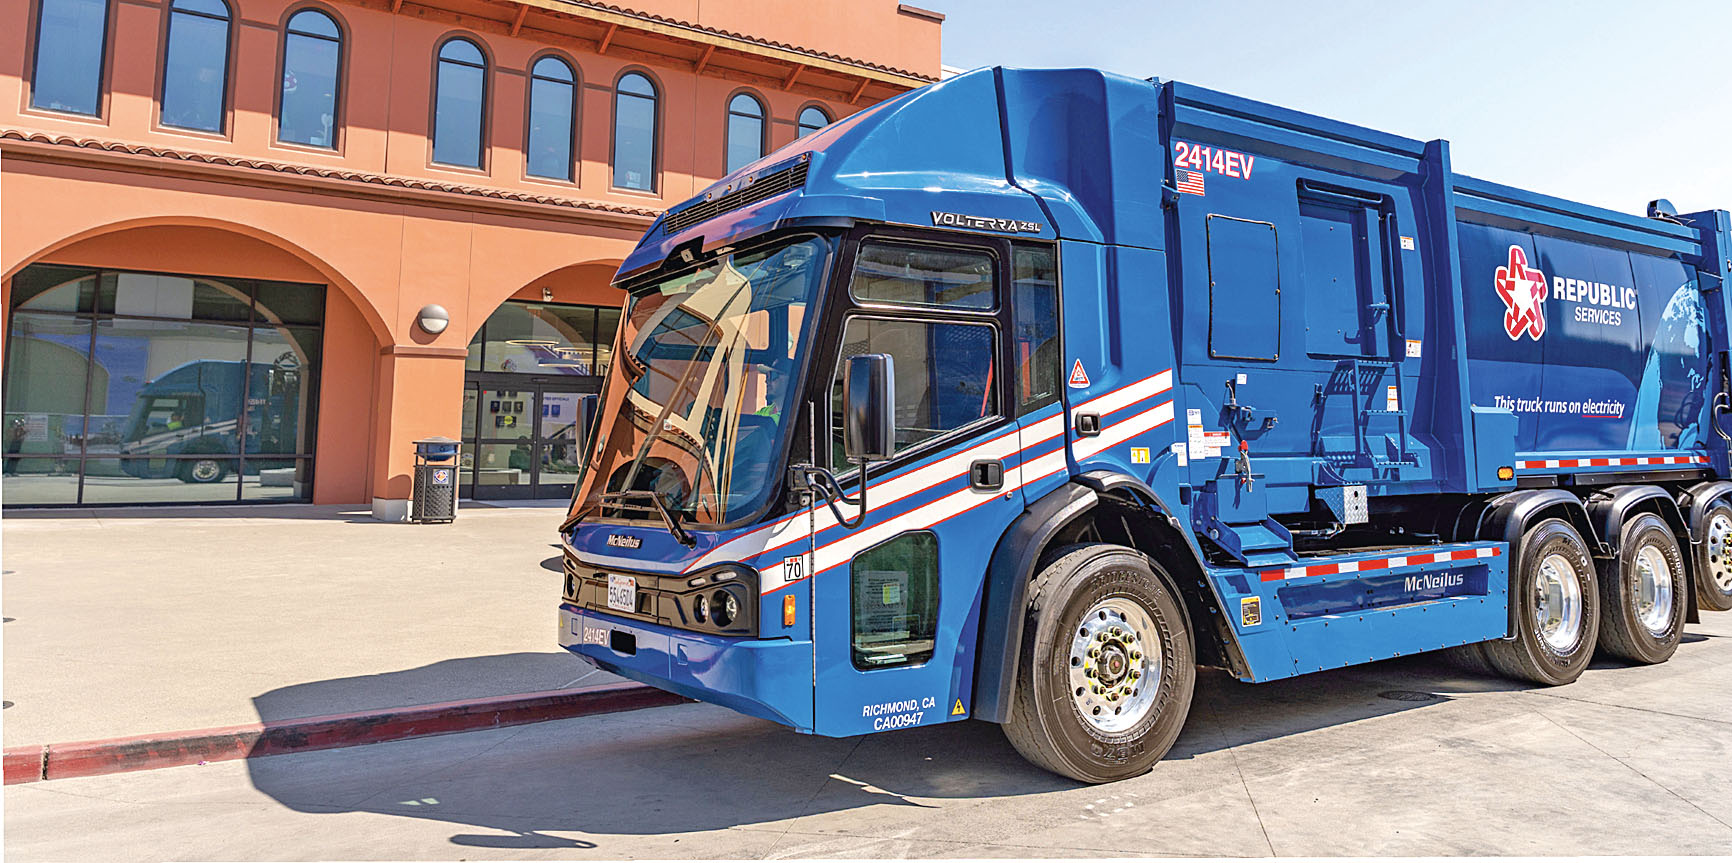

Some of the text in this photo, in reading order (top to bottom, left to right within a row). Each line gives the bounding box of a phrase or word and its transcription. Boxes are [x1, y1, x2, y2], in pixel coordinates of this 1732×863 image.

[1175, 141, 1255, 180] 2414EV
[932, 212, 1040, 231] VOLTERRA ZSL
[1553, 276, 1636, 310] REPUBLIC
[1575, 306, 1622, 326] SERVICES
[1494, 395, 1625, 418] This truck runs on electricity
[786, 562, 802, 579] 70
[1404, 572, 1464, 592] McNeilus
[583, 626, 610, 645] 2414EV
[862, 697, 936, 717] RICHMOND, CA
[873, 711, 924, 731] CA00947
